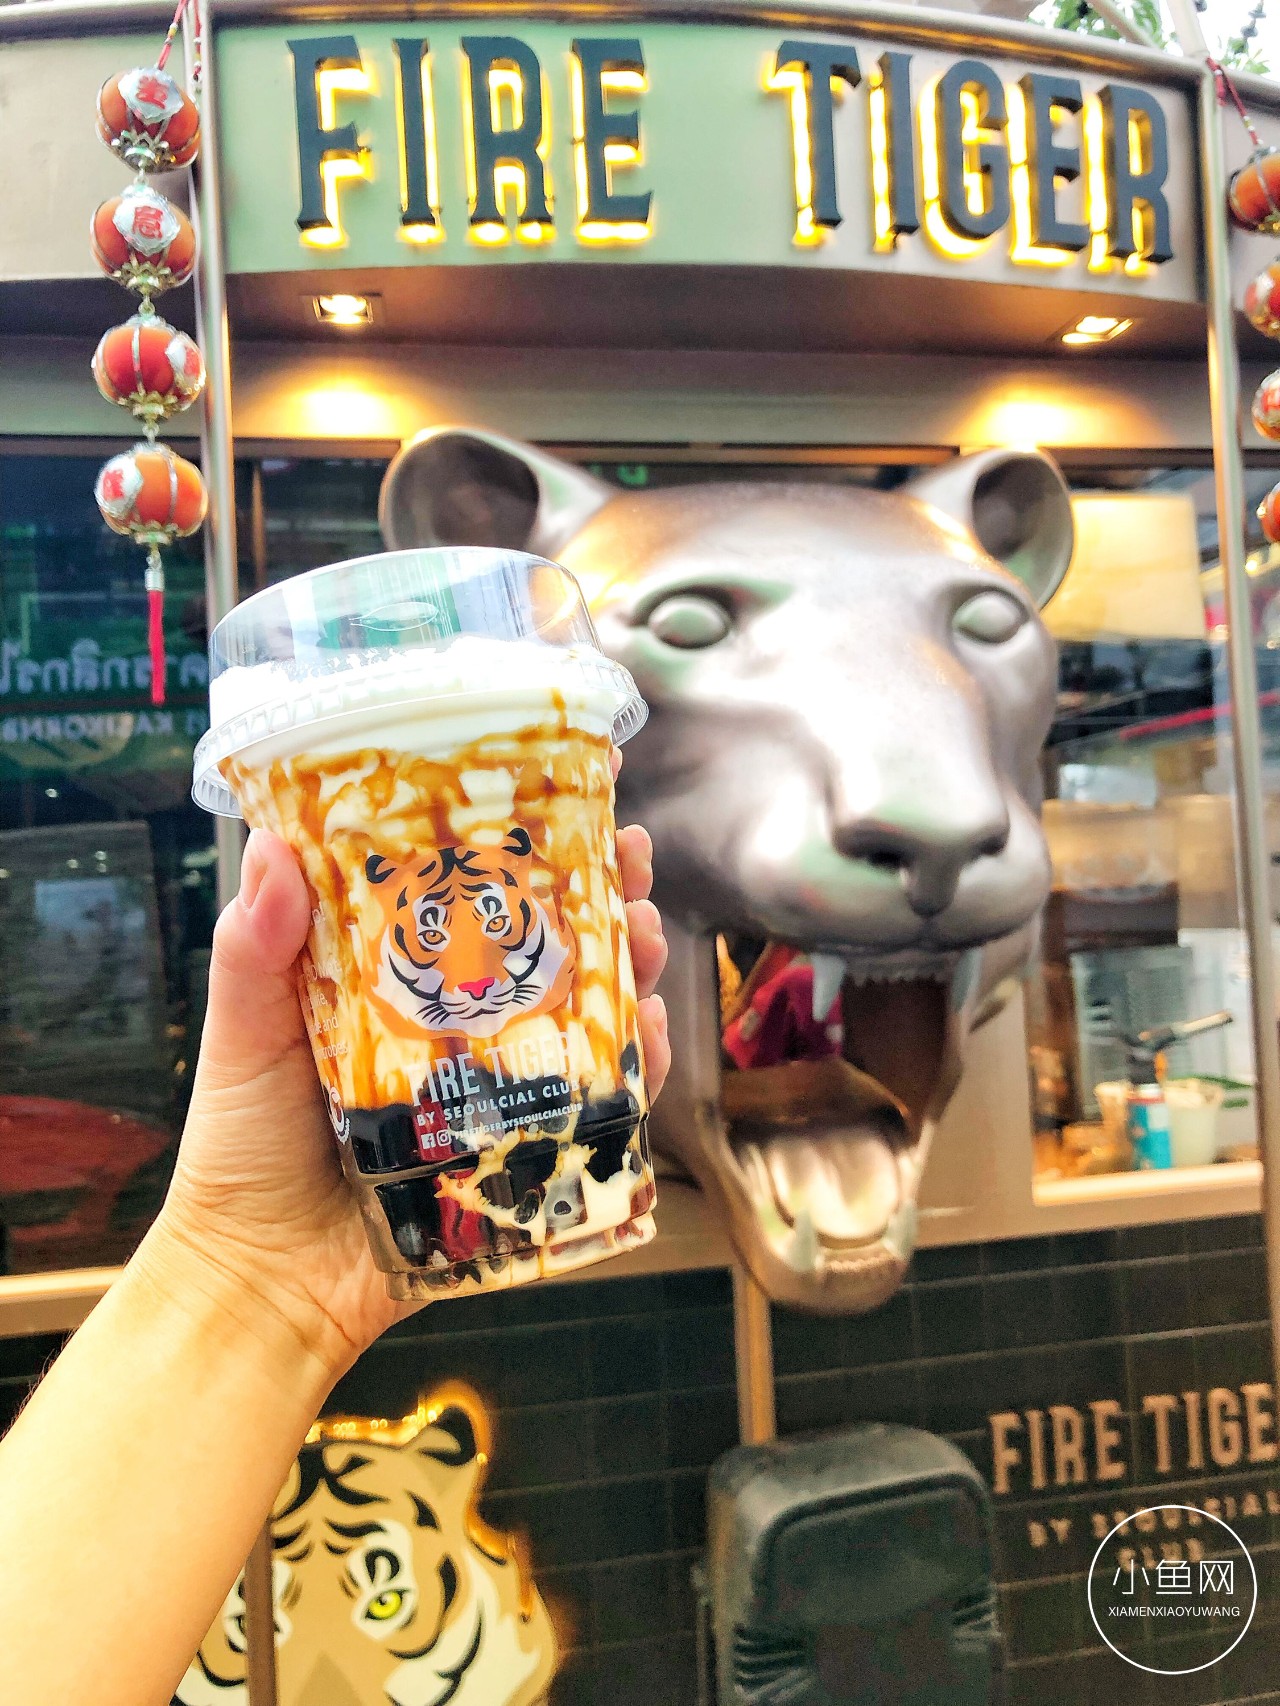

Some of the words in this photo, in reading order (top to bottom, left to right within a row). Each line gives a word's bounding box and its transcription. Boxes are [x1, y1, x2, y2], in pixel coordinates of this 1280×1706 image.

[286, 35, 655, 240] FIRE
[774, 40, 1175, 266] TIGER
[402, 1051, 480, 1107] FIRE
[484, 1031, 578, 1089] TIGER
[416, 1111, 436, 1127] BY
[444, 1089, 536, 1121] SEOULCIAL
[542, 1080, 579, 1099] CLUB
[988, 1399, 1127, 1494] FIRE
[1142, 1381, 1280, 1473] TIGE
